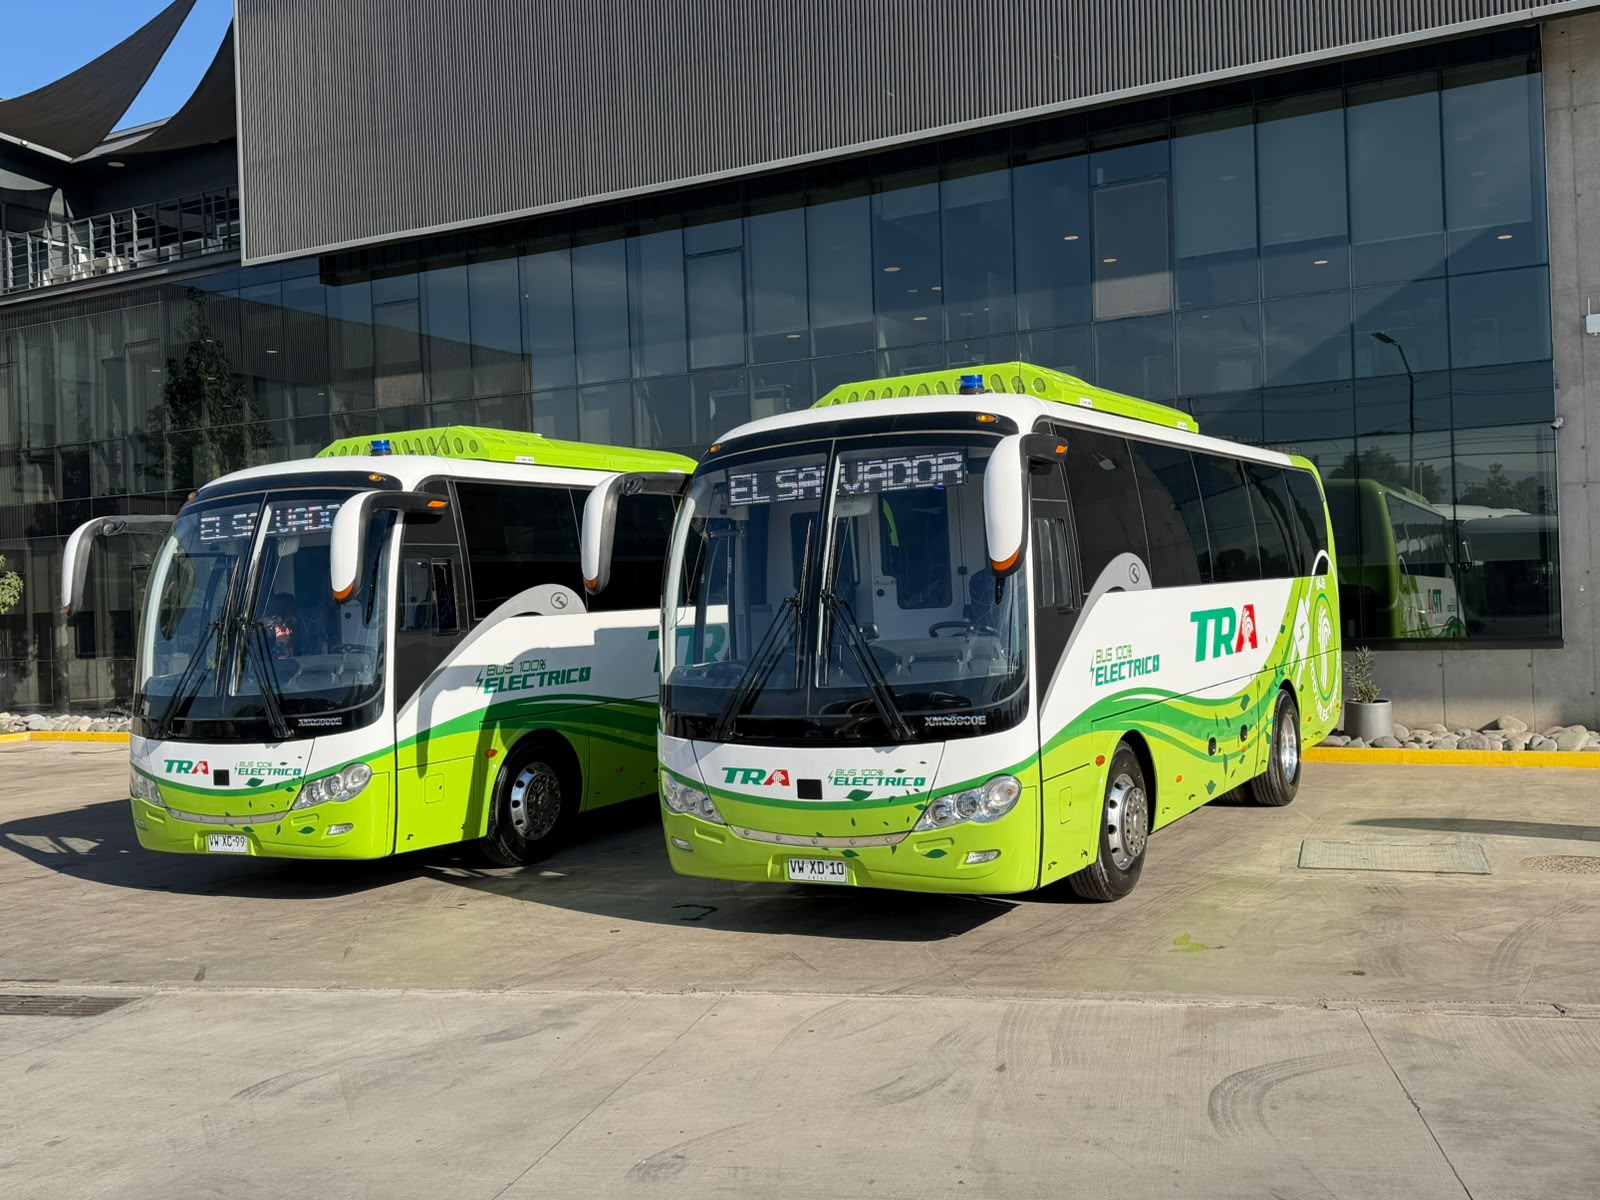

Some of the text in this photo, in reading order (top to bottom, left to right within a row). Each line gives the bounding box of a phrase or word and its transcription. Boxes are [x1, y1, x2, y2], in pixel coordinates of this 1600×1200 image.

[730, 473, 770, 506] EL
[1190, 604, 1258, 663] TRA
[1095, 644, 1133, 665] BUS 100%
[486, 658, 547, 676] BUS 100%
[1095, 654, 1161, 687] ELECTRICO
[484, 666, 592, 694] ELECTRICO
[164, 759, 210, 775] TRA
[238, 768, 302, 776] ELECTRICO
[721, 767, 791, 787] TRA
[860, 768, 884, 776] 100%
[833, 776, 926, 787] ELECTRICO
